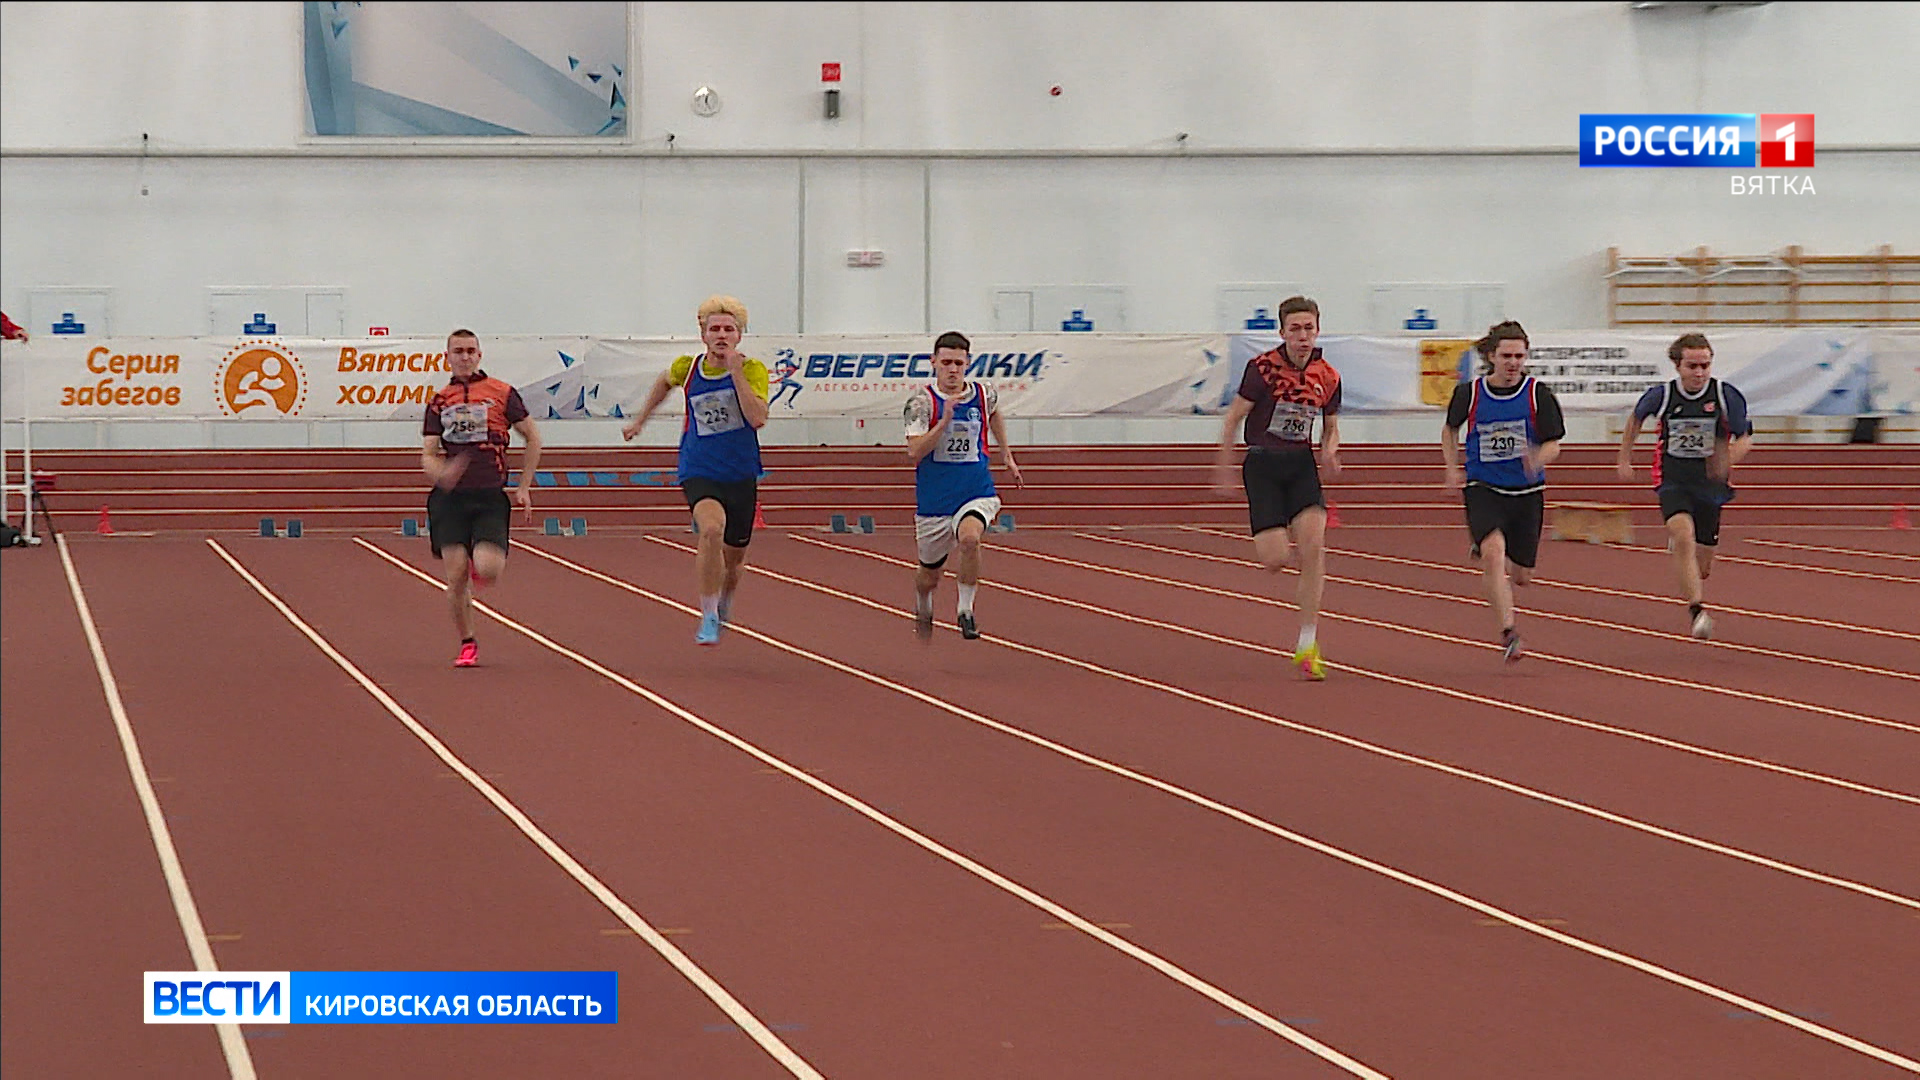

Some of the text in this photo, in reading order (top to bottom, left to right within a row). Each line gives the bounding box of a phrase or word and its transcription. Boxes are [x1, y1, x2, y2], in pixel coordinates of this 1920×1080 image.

[86, 346, 180, 381] Серия
[803, 353, 1046, 378] ВЕРЕСИКИ
[60, 378, 182, 407] забегов
[947, 438, 971, 452] 228
[1490, 436, 1516, 454] 230
